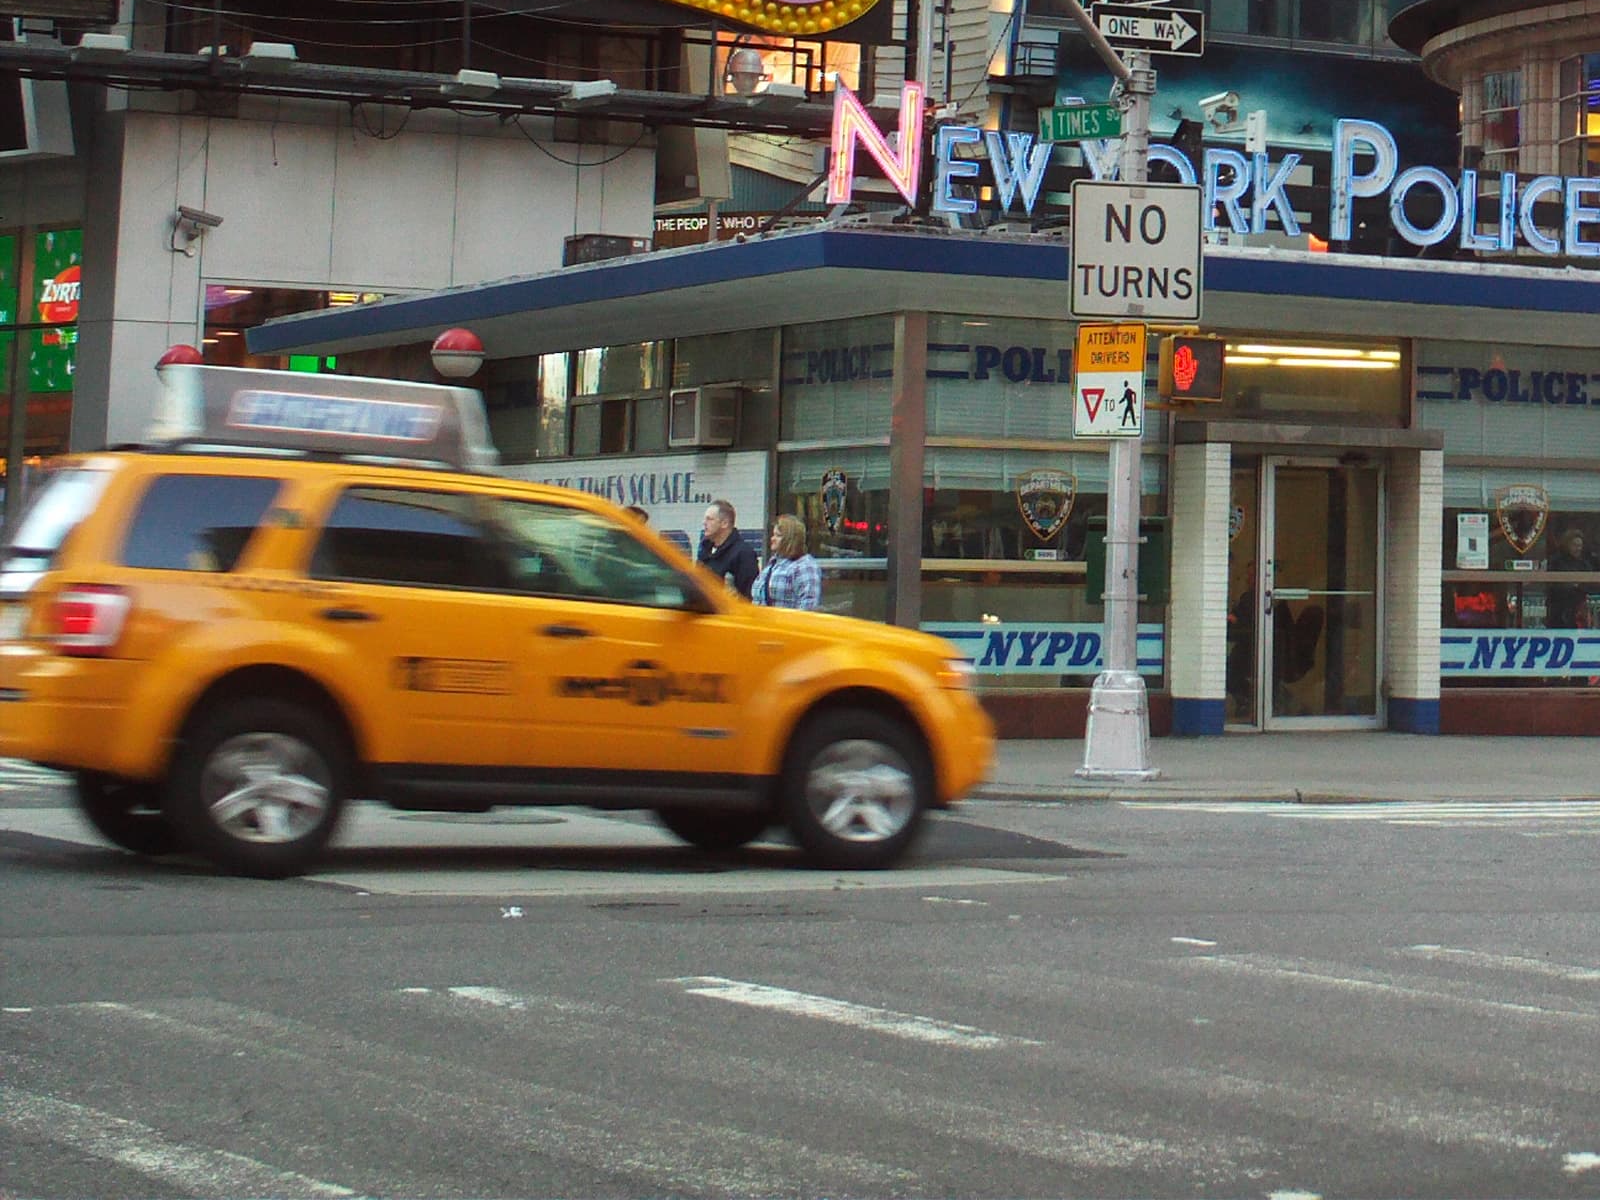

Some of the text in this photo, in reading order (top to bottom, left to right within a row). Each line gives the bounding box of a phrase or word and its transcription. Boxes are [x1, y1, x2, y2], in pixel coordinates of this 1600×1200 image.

[1108, 18, 1188, 40] ONE WAY
[1058, 110, 1100, 136] TIMES
[826, 76, 1054, 219] NEW
[656, 219, 676, 231] THE
[677, 217, 722, 231] PEOPE
[724, 216, 754, 229] WHO
[1104, 203, 1167, 246] NO
[41, 279, 80, 303] ZYRT
[1077, 264, 1193, 300] TURNS
[1087, 331, 1138, 346] ATTENTION
[806, 345, 873, 385] POLICE
[974, 345, 1070, 385] POLI
[1090, 350, 1131, 366] DRIVERS
[1455, 367, 1591, 405] POLICE
[1103, 398, 1115, 412] TO
[979, 630, 1105, 667] NYPD
[1468, 637, 1577, 670] NYPD
